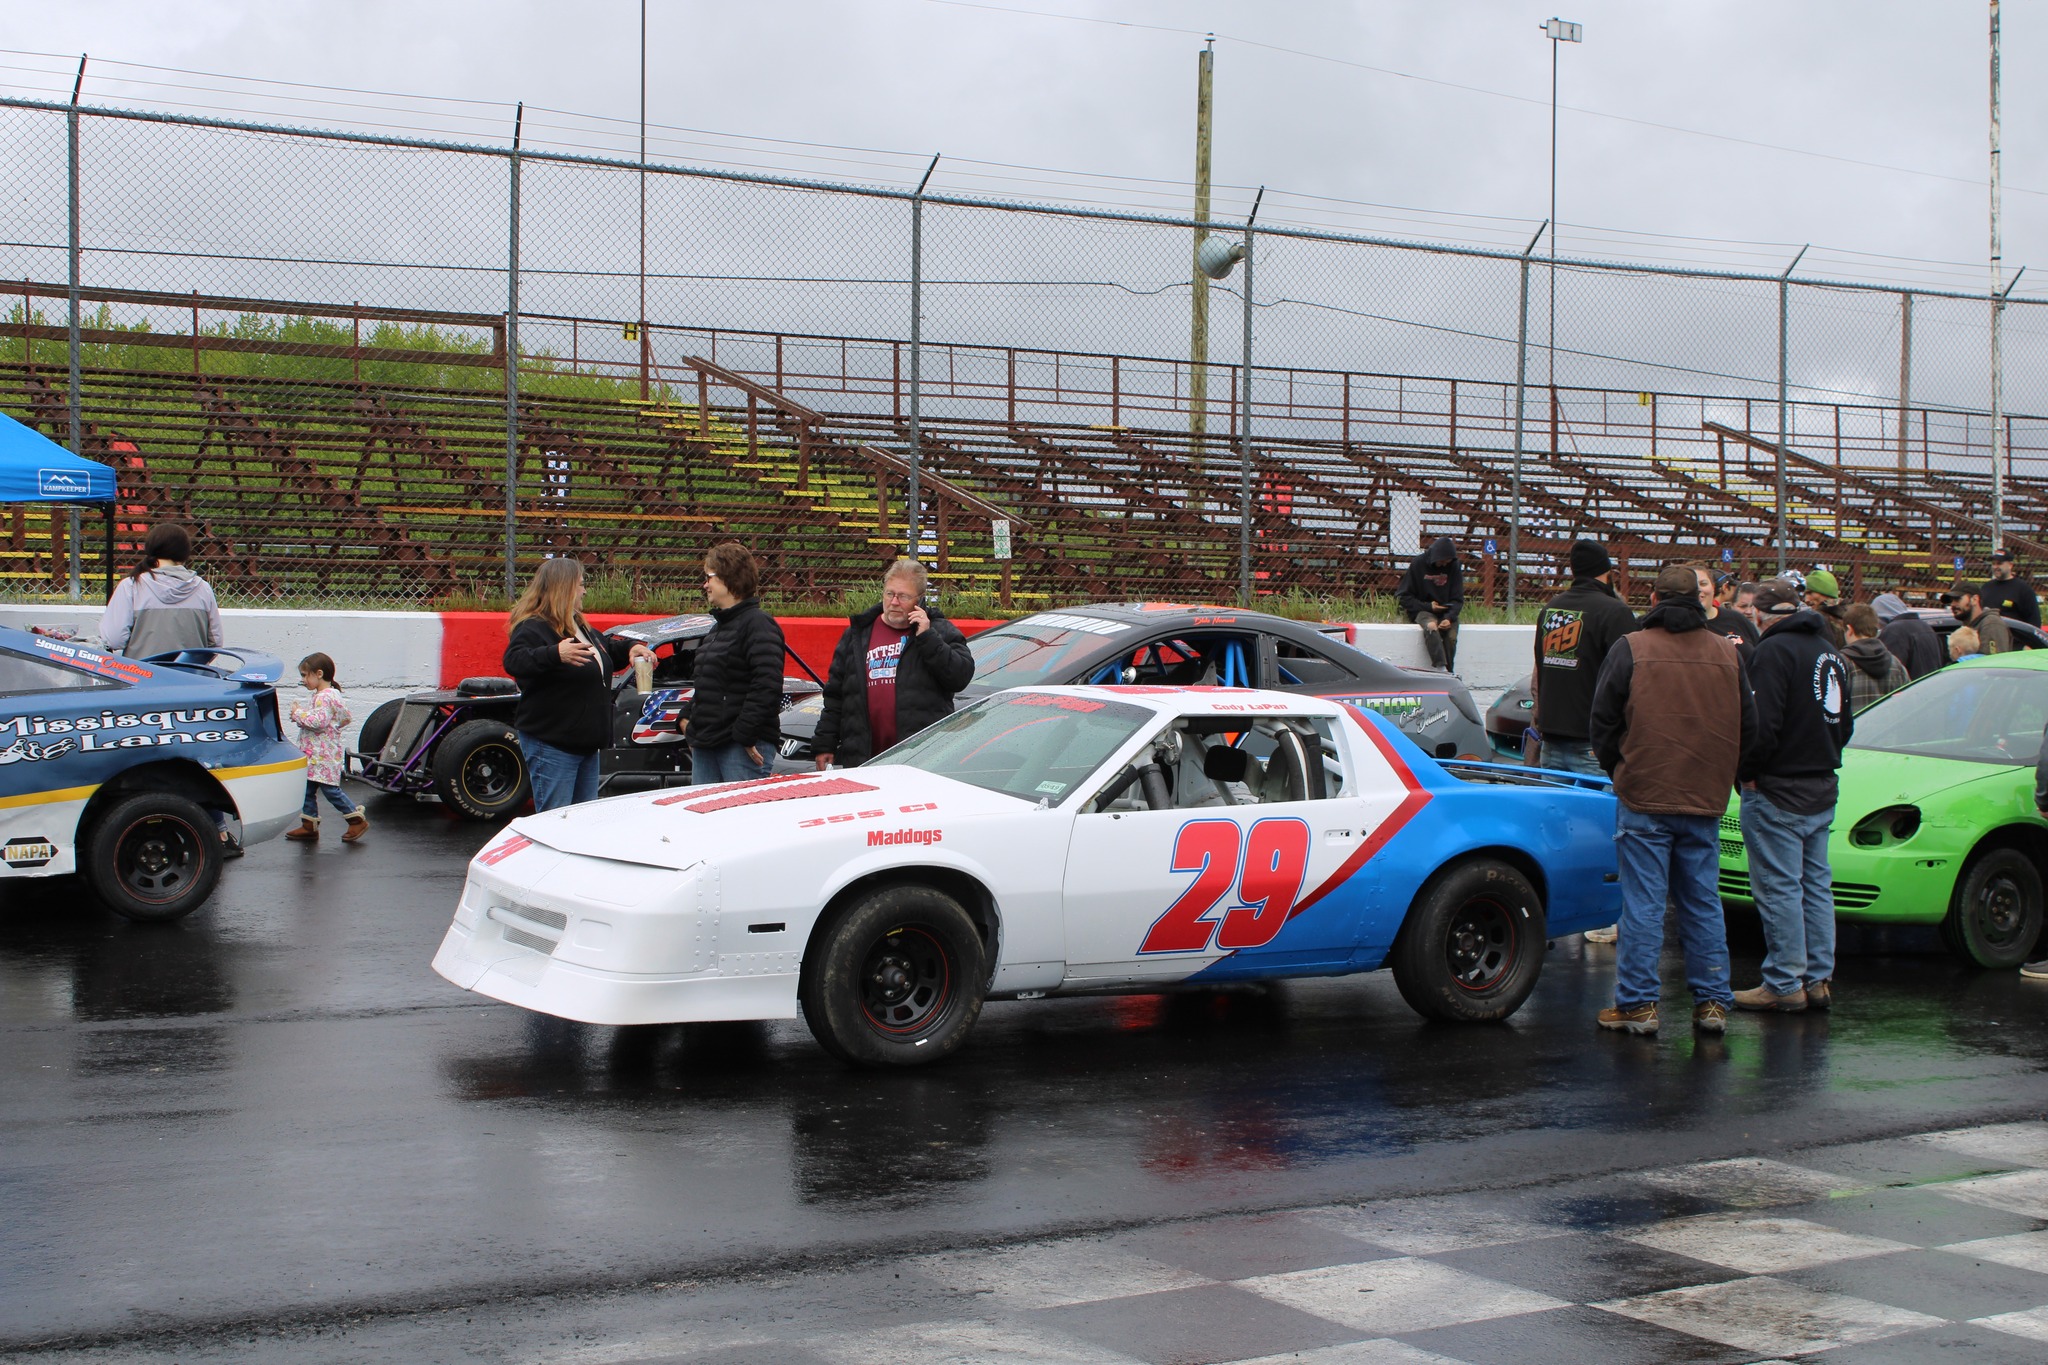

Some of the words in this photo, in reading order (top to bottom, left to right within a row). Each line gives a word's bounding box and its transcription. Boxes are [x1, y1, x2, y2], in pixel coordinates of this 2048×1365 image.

[43, 484, 87, 493] KAMPKEEPER
[35, 638, 76, 658] Young
[78, 648, 103, 663] Gun
[100, 656, 153, 679] Creations
[866, 641, 905, 660] ITTSB
[1212, 703, 1245, 711] Cody
[0, 701, 249, 737] Missisquoi
[79, 732, 250, 753] Lanes
[450, 778, 495, 820] AMERICAN
[798, 808, 886, 829] 355
[899, 802, 938, 813] CI
[867, 828, 943, 847] Maddogs
[7, 844, 50, 860] NAPA
[1136, 816, 1311, 955] 29
